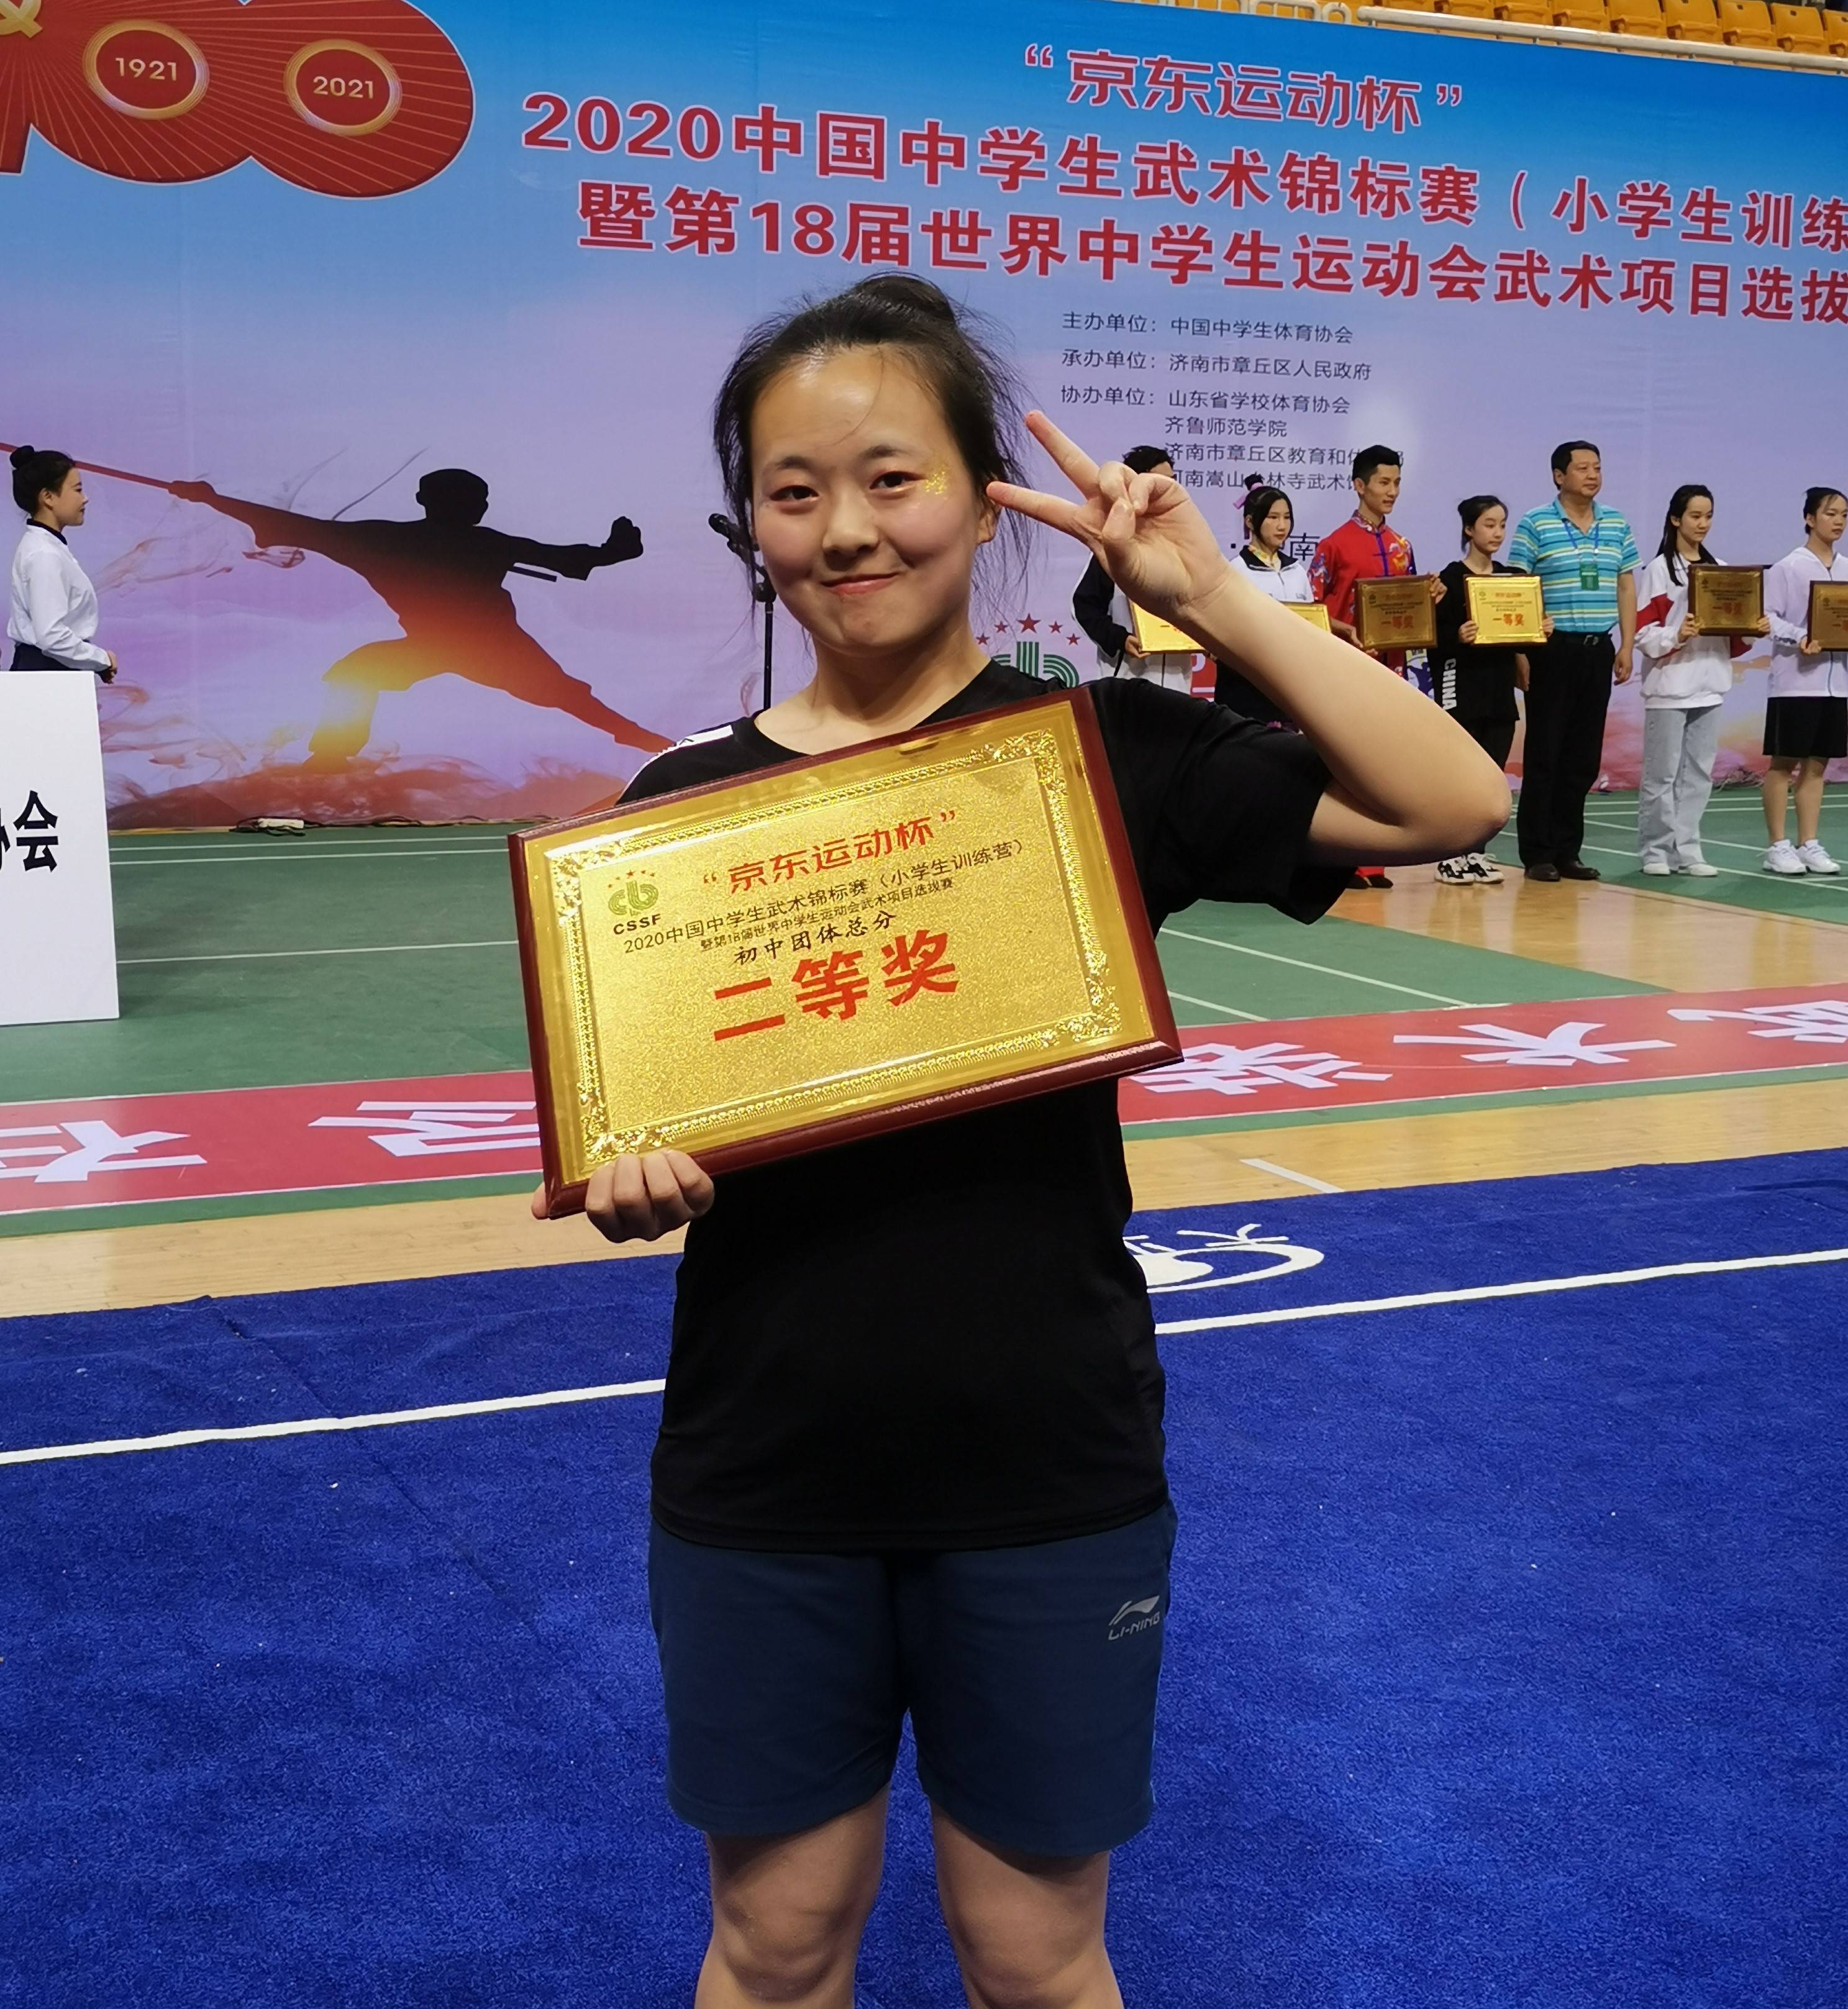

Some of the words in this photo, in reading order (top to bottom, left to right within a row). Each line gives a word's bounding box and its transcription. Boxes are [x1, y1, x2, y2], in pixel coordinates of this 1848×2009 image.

[115, 57, 178, 81] 1921
[312, 76, 374, 99] 2021
[1024, 43, 1462, 134] “京东运动杯”
[1165, 416, 1288, 438] 齐鲁师范学院
[1442, 658, 1457, 710] CHINA
[703, 809, 956, 895] “京东运动杯”
[612, 913, 662, 935] CSSF
[734, 909, 897, 965] 初中团体总分
[712, 928, 960, 1042] 二等奖
[1108, 1611, 1160, 1641] LI-NING
